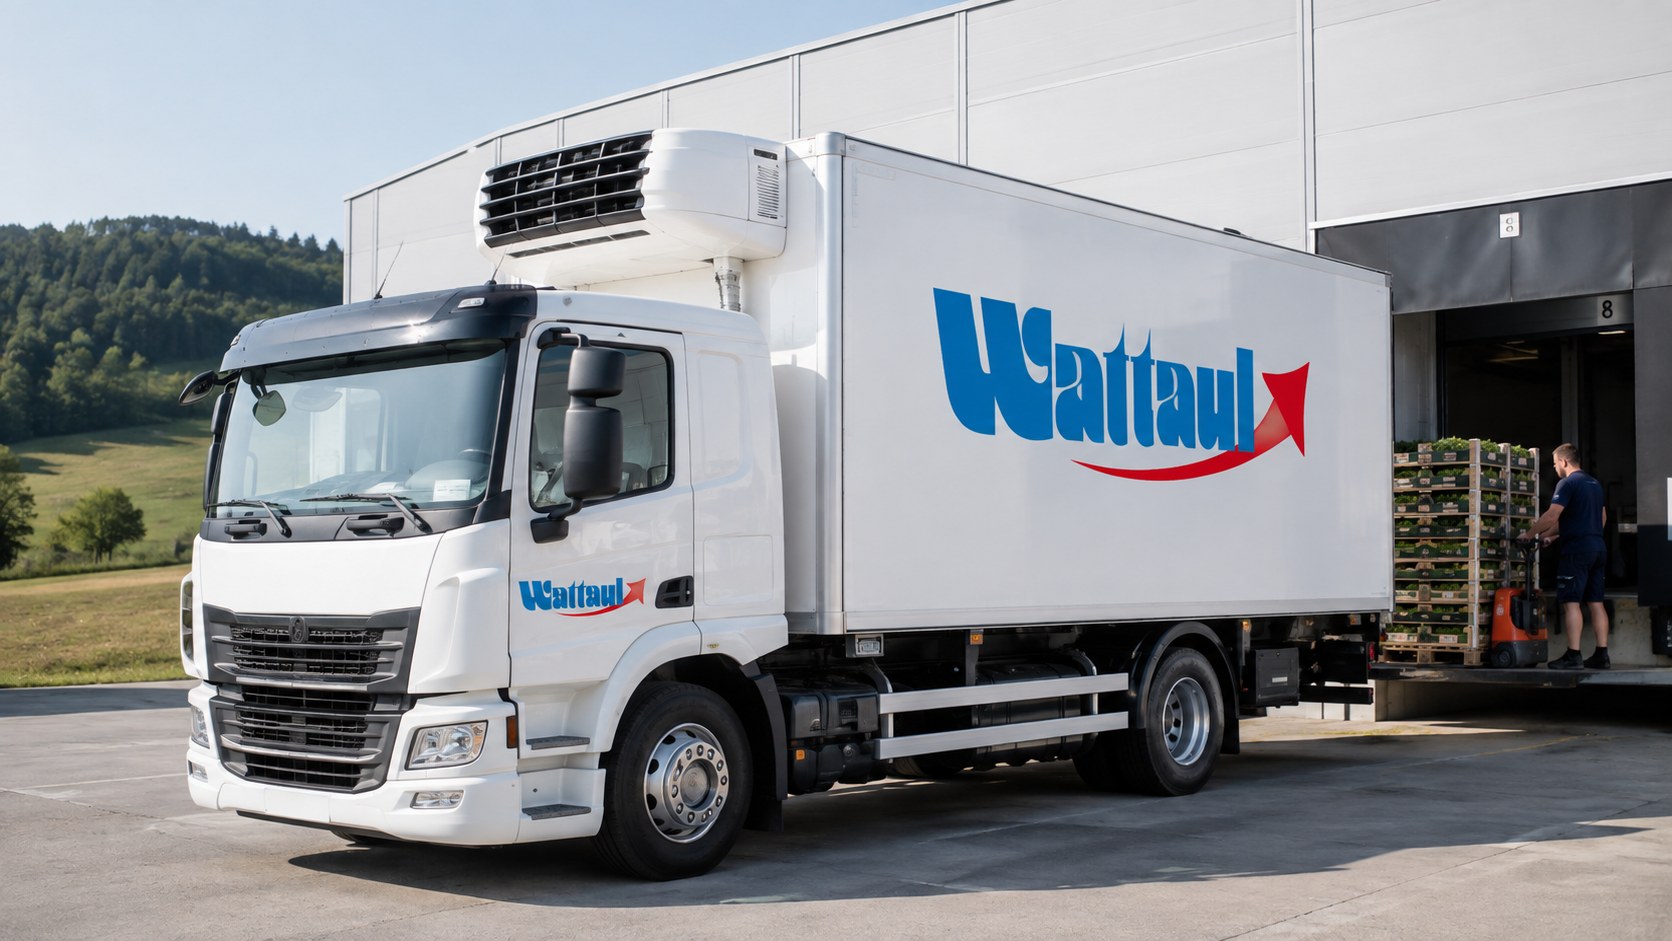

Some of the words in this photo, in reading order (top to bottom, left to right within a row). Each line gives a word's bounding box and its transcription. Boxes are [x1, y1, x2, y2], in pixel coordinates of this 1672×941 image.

[1601, 300, 1613, 319] 8
[933, 287, 1255, 453] Wattaul
[518, 577, 624, 611] Wattaul
